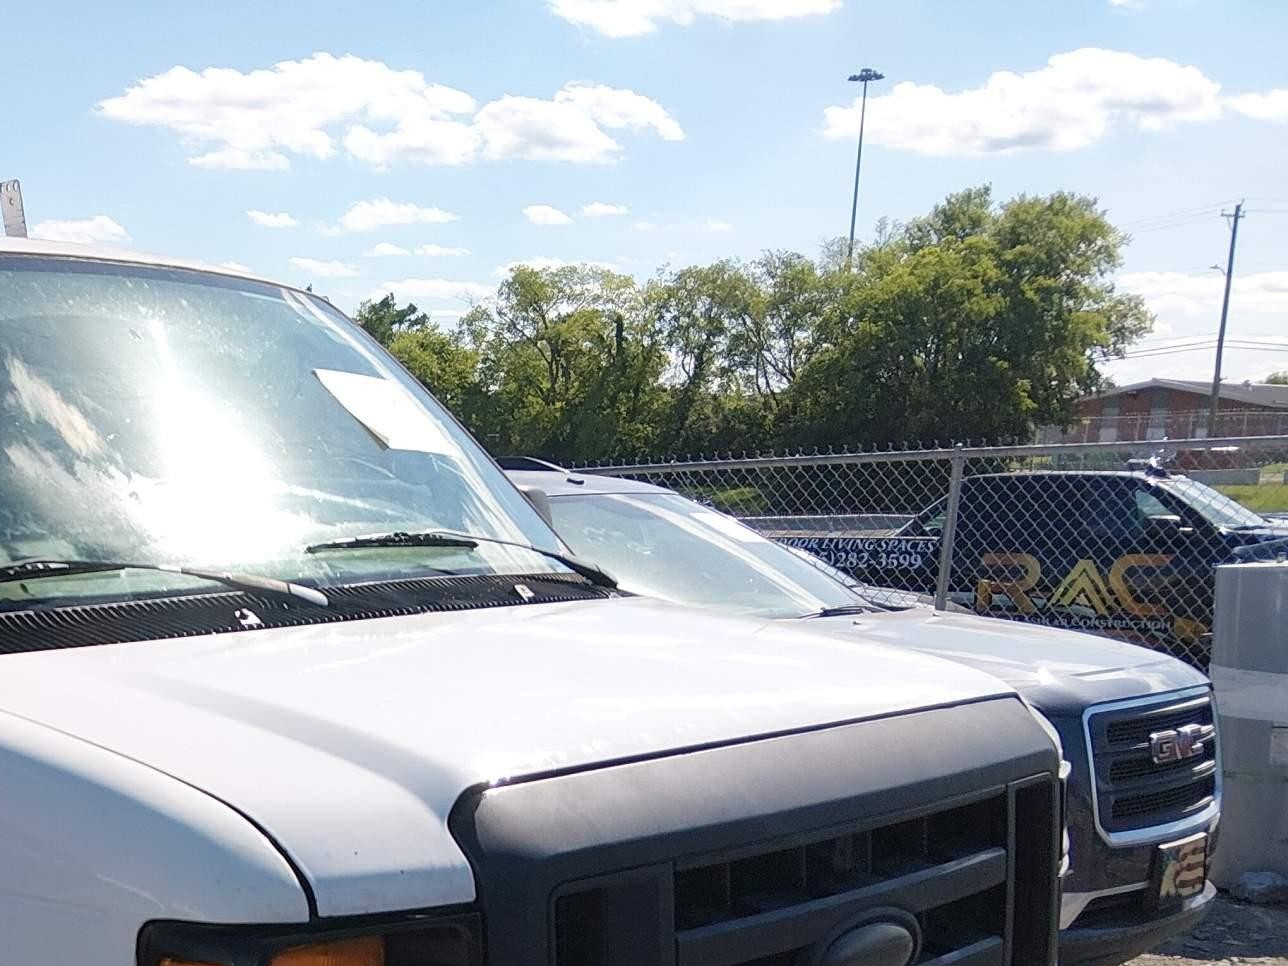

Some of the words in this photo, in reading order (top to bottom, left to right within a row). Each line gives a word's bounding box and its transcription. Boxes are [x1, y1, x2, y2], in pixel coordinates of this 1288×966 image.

[778, 538, 819, 549] DOOR
[821, 538, 875, 550] LIVING
[879, 540, 935, 552] SPACES
[816, 551, 922, 570] 5)282-3599
[976, 552, 1176, 616] RAC
[1070, 617, 1172, 630] CONSTRUCTION
[1149, 724, 1204, 764] GMC
